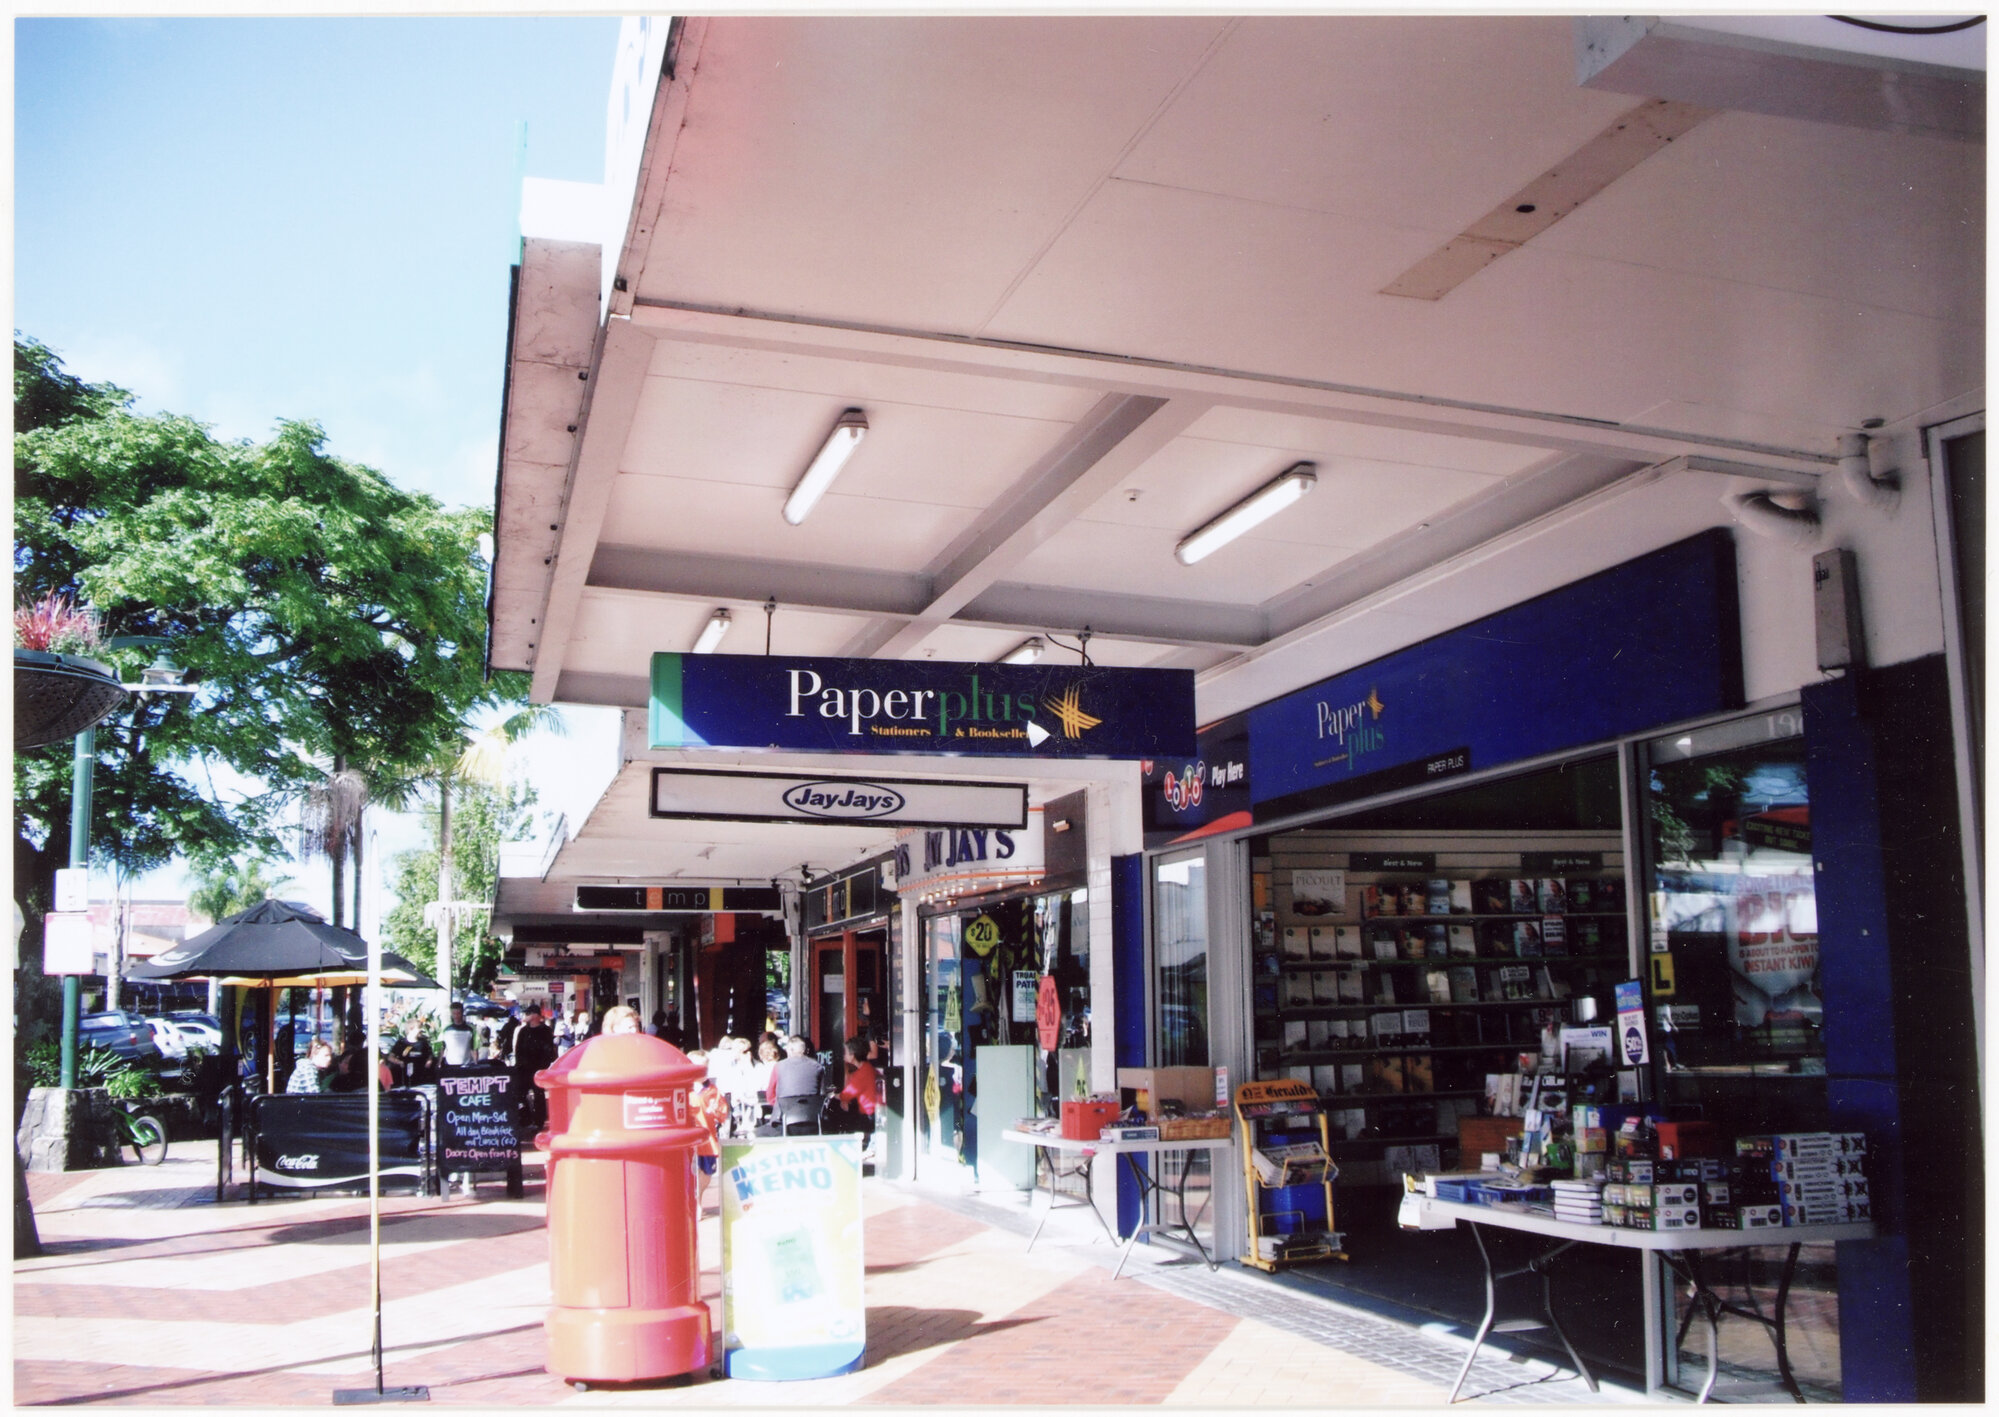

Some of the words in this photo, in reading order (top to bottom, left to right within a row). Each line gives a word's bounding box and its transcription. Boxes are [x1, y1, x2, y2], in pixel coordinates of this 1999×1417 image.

[871, 725, 931, 736] Stationers
[955, 727, 964, 737] &
[1317, 699, 1366, 746] Paper
[1347, 716, 1384, 770] plus
[1427, 760, 1446, 774] PAPER
[1448, 755, 1464, 769] PLUS
[1212, 766, 1226, 788] Play
[1227, 761, 1244, 782] Here
[971, 923, 992, 942] $20
[1653, 959, 1671, 990] L
[1590, 1030, 1607, 1038] WIN
[440, 1075, 511, 1095] TEMPT
[459, 1095, 491, 1106] CAFE
[446, 1110, 471, 1126] Open
[731, 1147, 826, 1182] INSTANT
[735, 1166, 833, 1201] KENO
